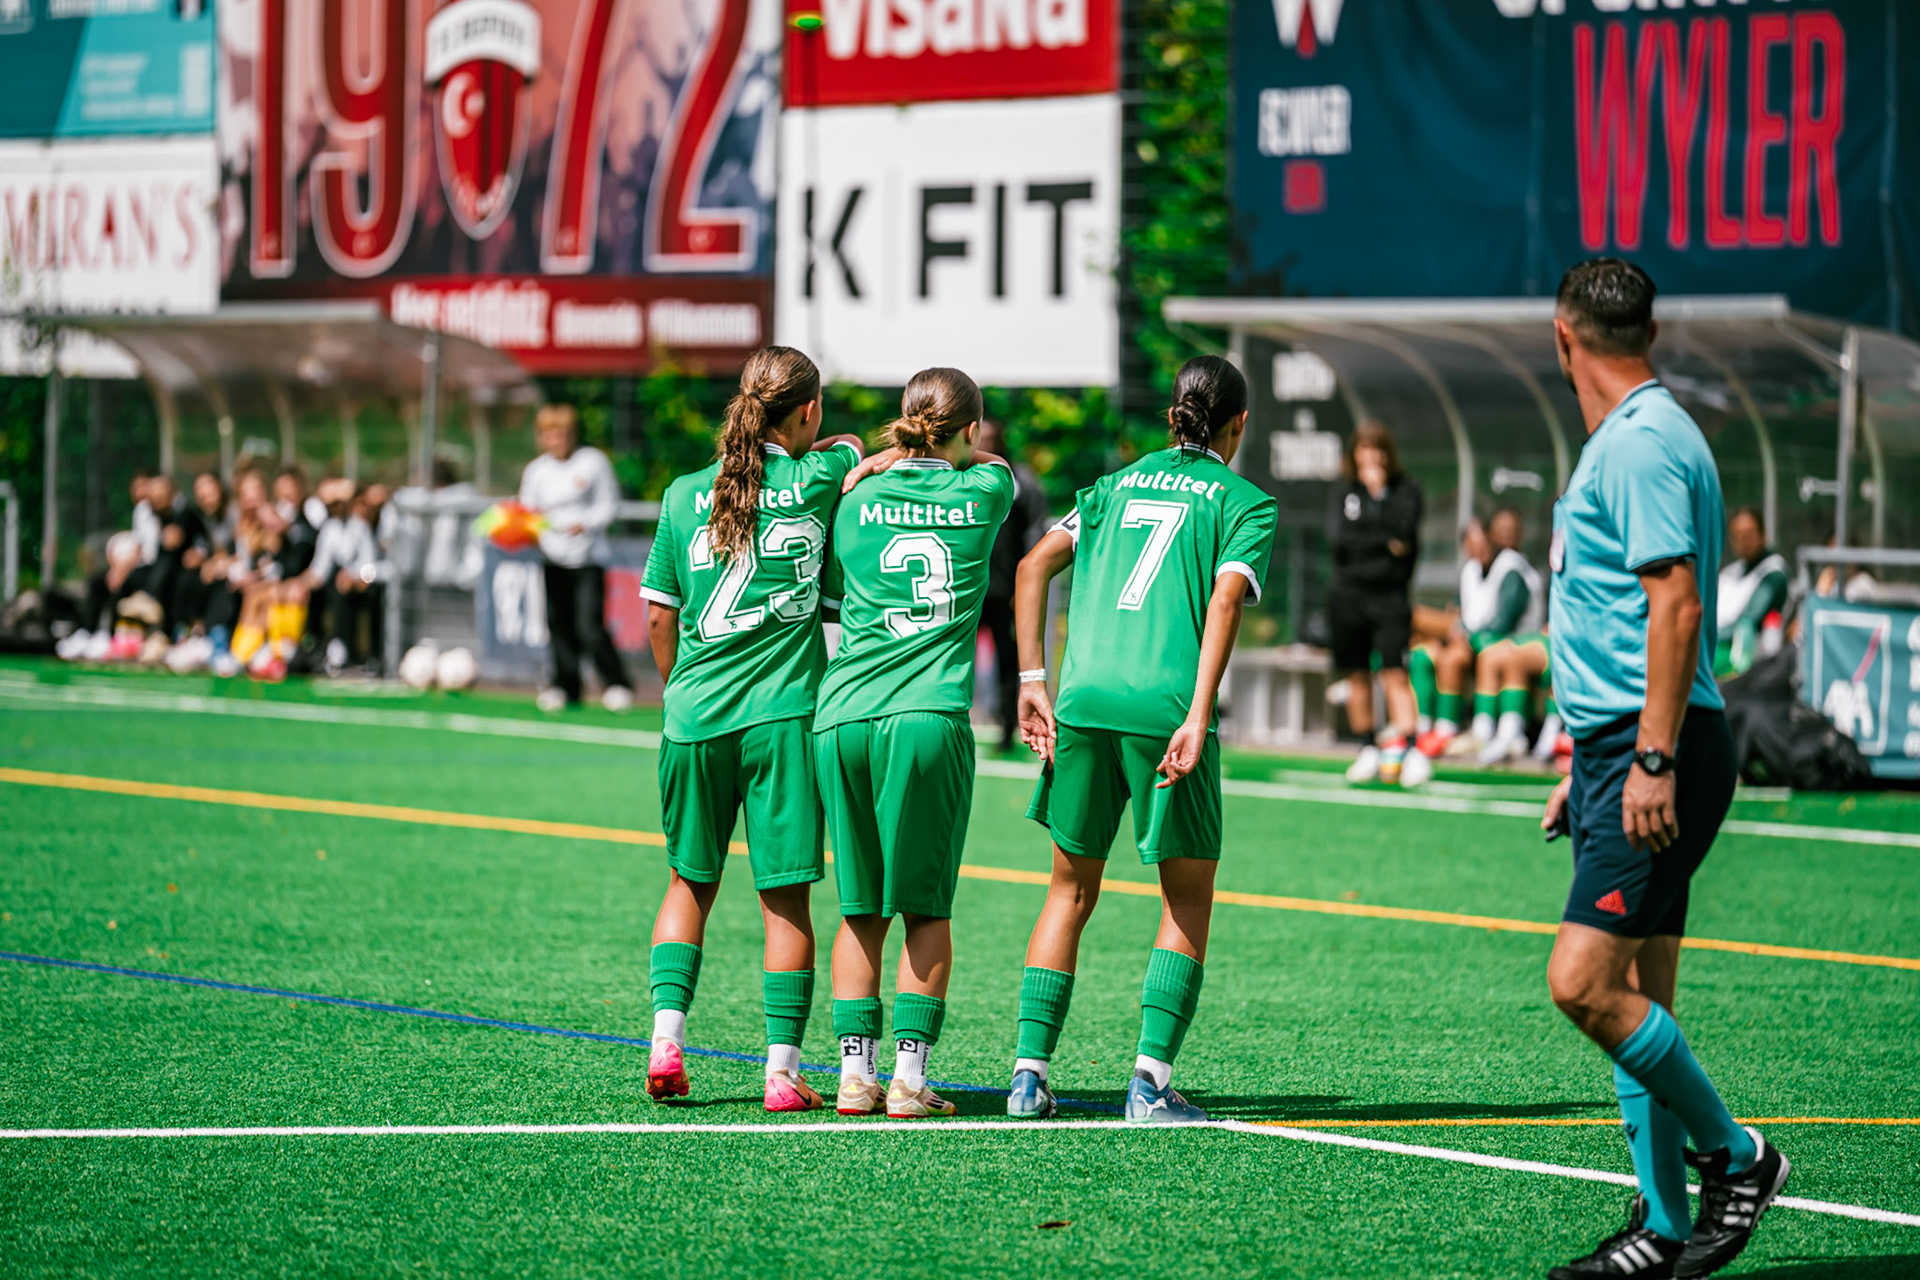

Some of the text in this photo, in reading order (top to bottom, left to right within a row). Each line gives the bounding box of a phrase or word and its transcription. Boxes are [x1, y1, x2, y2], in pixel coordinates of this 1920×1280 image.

[1572, 14, 1847, 251] WYLER
[806, 181, 1094, 299] K FIT
[695, 482, 804, 514] Mitel
[859, 501, 976, 526] Multitel
[1115, 471, 1219, 500] Multitel
[689, 514, 826, 642] 23
[880, 532, 956, 639] 3
[1116, 499, 1189, 611] 7
